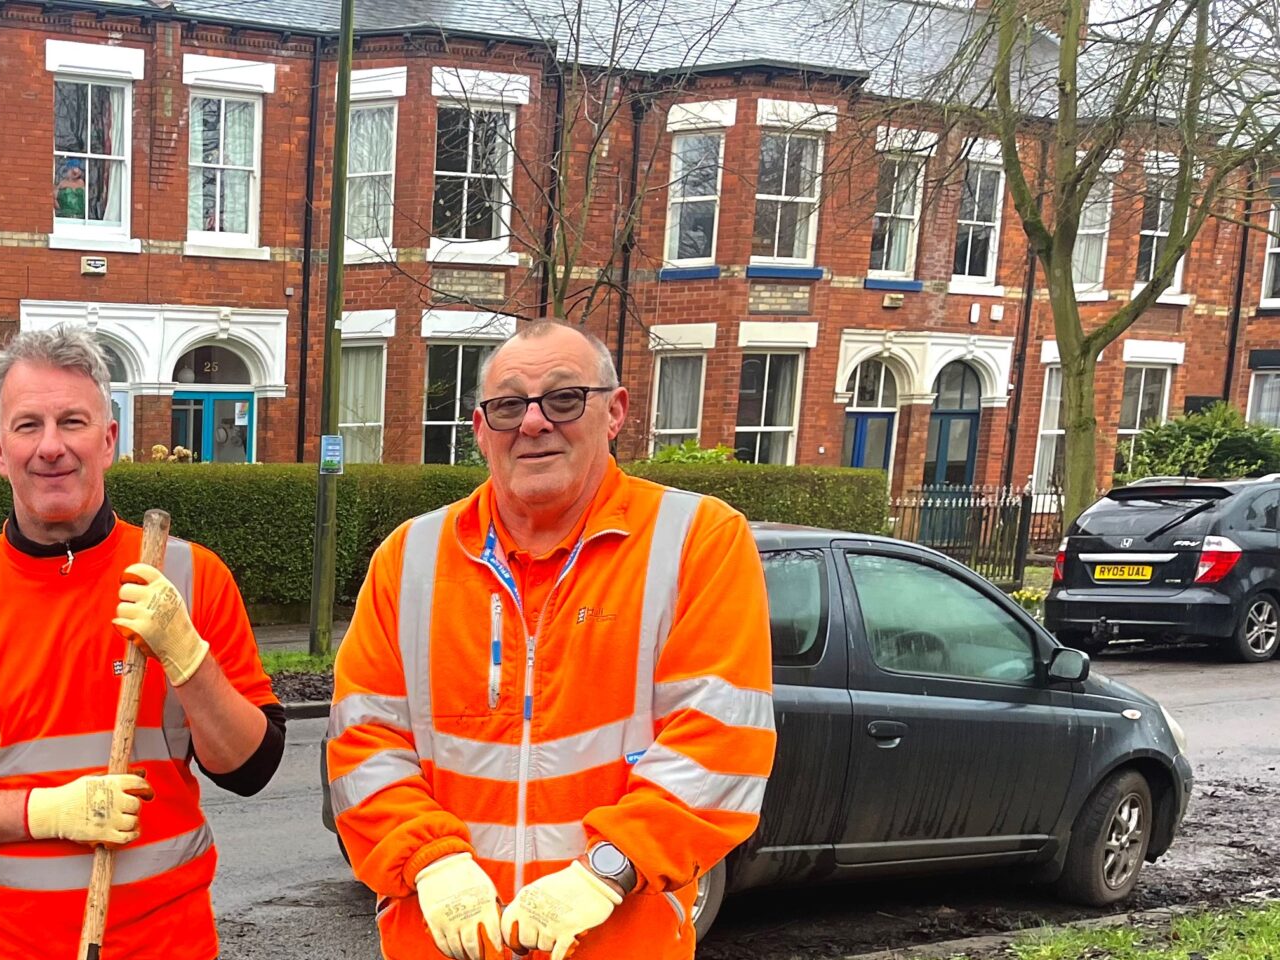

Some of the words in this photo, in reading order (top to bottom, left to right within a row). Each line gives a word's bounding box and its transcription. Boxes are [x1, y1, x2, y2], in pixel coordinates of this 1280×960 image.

[204, 361, 219, 372] 25
[1099, 566, 1126, 577] RY05
[1127, 566, 1147, 577] UAL
